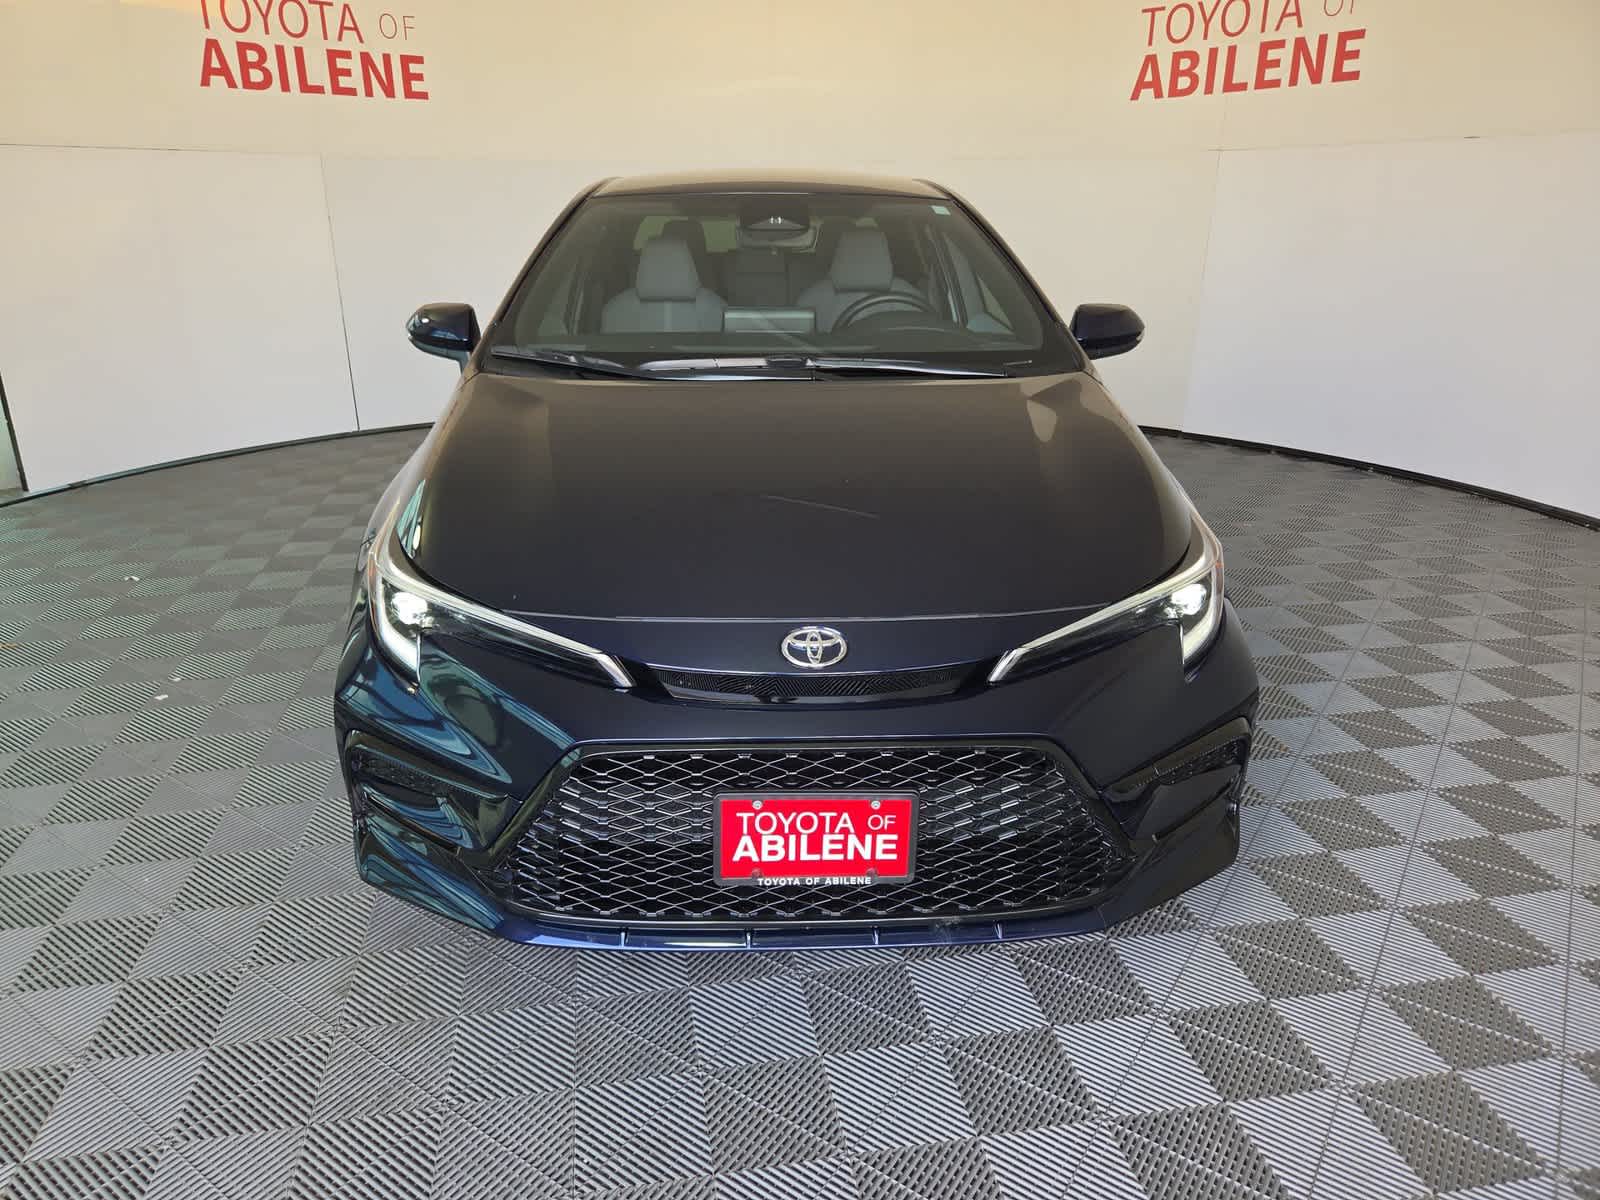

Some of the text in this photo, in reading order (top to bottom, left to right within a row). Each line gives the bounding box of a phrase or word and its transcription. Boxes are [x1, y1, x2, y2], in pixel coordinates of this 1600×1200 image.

[379, 13, 415, 41] OF
[200, 38, 429, 100] ABILENE
[1130, 28, 1366, 101] ABILENE
[736, 812, 896, 835] TOYOTA OF
[732, 833, 899, 862] ABILENE
[758, 876, 872, 886] TOYOTA OF ABILENE
